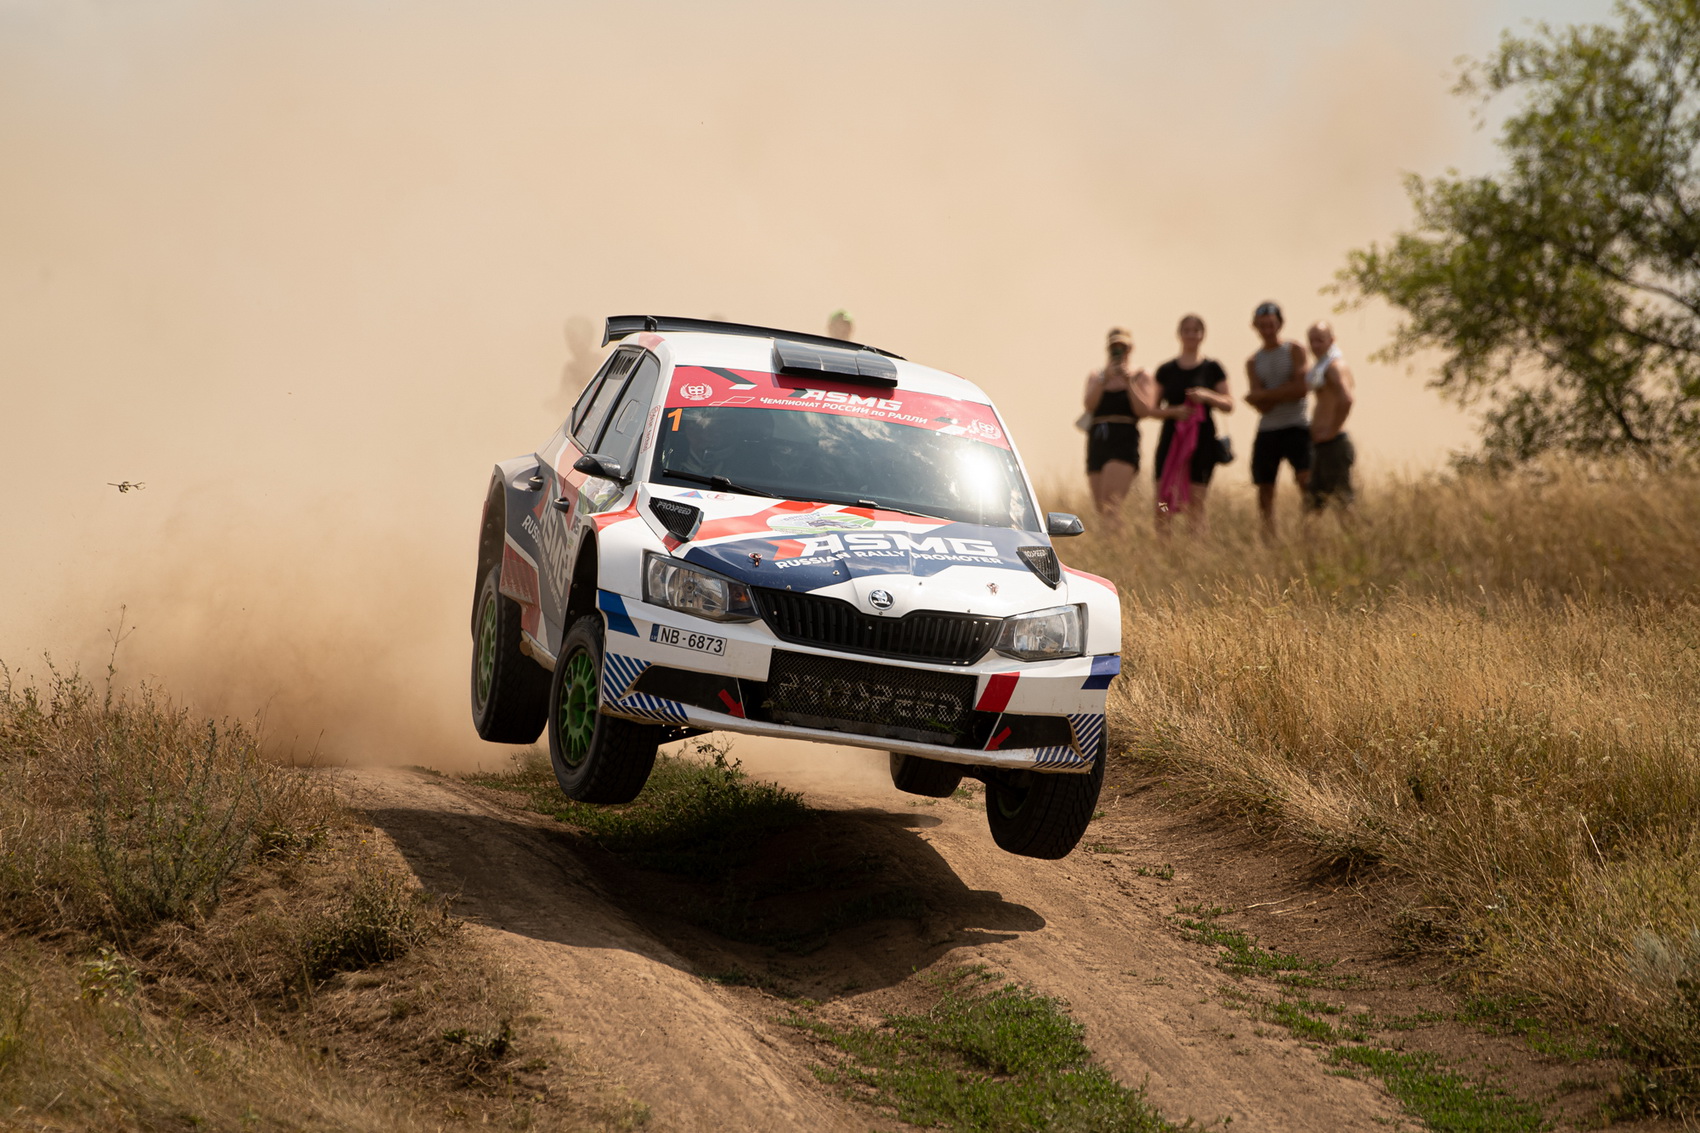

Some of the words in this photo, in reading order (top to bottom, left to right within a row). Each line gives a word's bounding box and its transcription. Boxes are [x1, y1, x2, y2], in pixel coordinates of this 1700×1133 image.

[800, 388, 903, 411] ASMG
[667, 408, 683, 431] 1
[822, 403, 869, 414] РОССИИ
[887, 412, 928, 424] РАЛЛИ
[657, 501, 692, 515] PROSPEED
[799, 533, 998, 557] ASMG
[775, 552, 851, 569] RUSSIAN
[854, 550, 905, 558] RALLY
[911, 553, 1004, 564] PROMOTER
[660, 628, 723, 653] NB-6873
